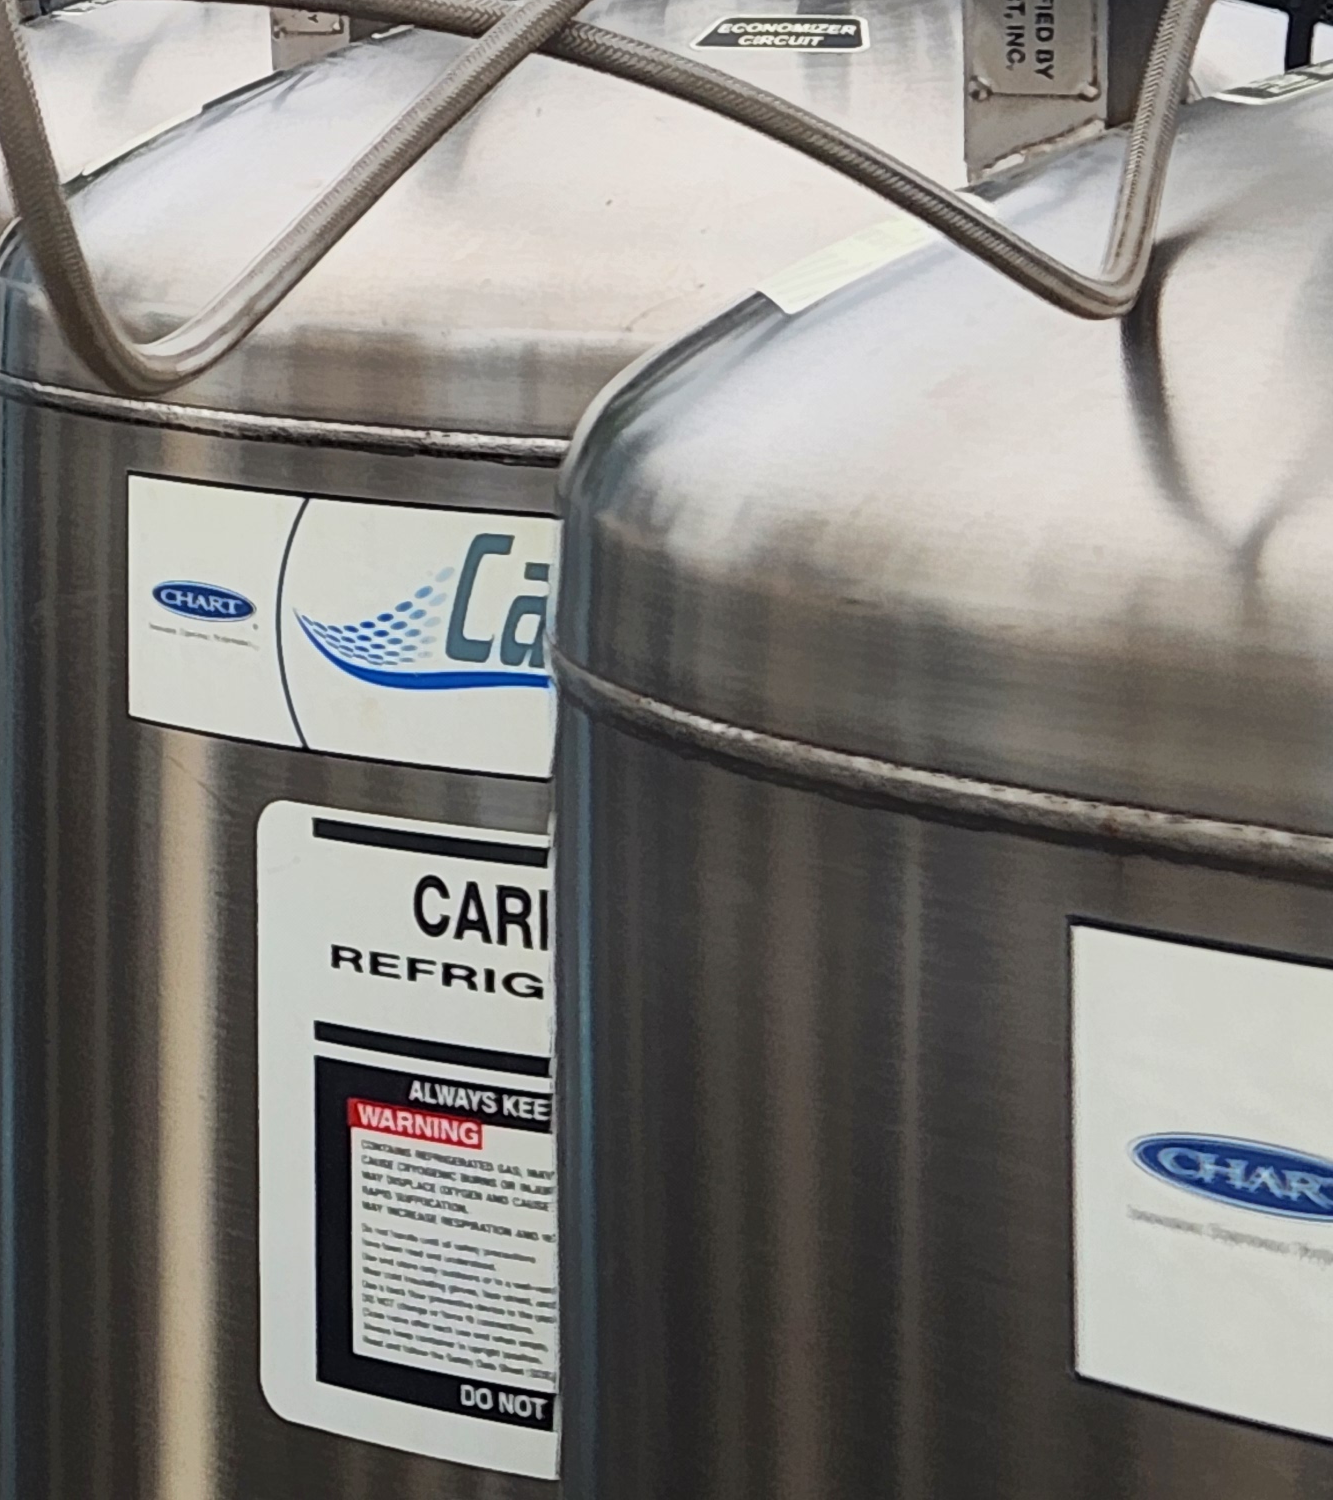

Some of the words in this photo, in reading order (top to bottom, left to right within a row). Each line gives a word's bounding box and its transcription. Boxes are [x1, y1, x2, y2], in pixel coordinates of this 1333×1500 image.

[716, 22, 858, 36] ECONOMIZER
[736, 34, 825, 47] CIRCUIT
[1004, 24, 1027, 71] INC.
[1034, 48, 1055, 81] BY
[159, 587, 244, 617] CHART
[407, 1079, 499, 1115] ALWAYS
[356, 1103, 480, 1146] WARNING
[459, 1384, 494, 1412] DO
[497, 1389, 548, 1422] NOT
